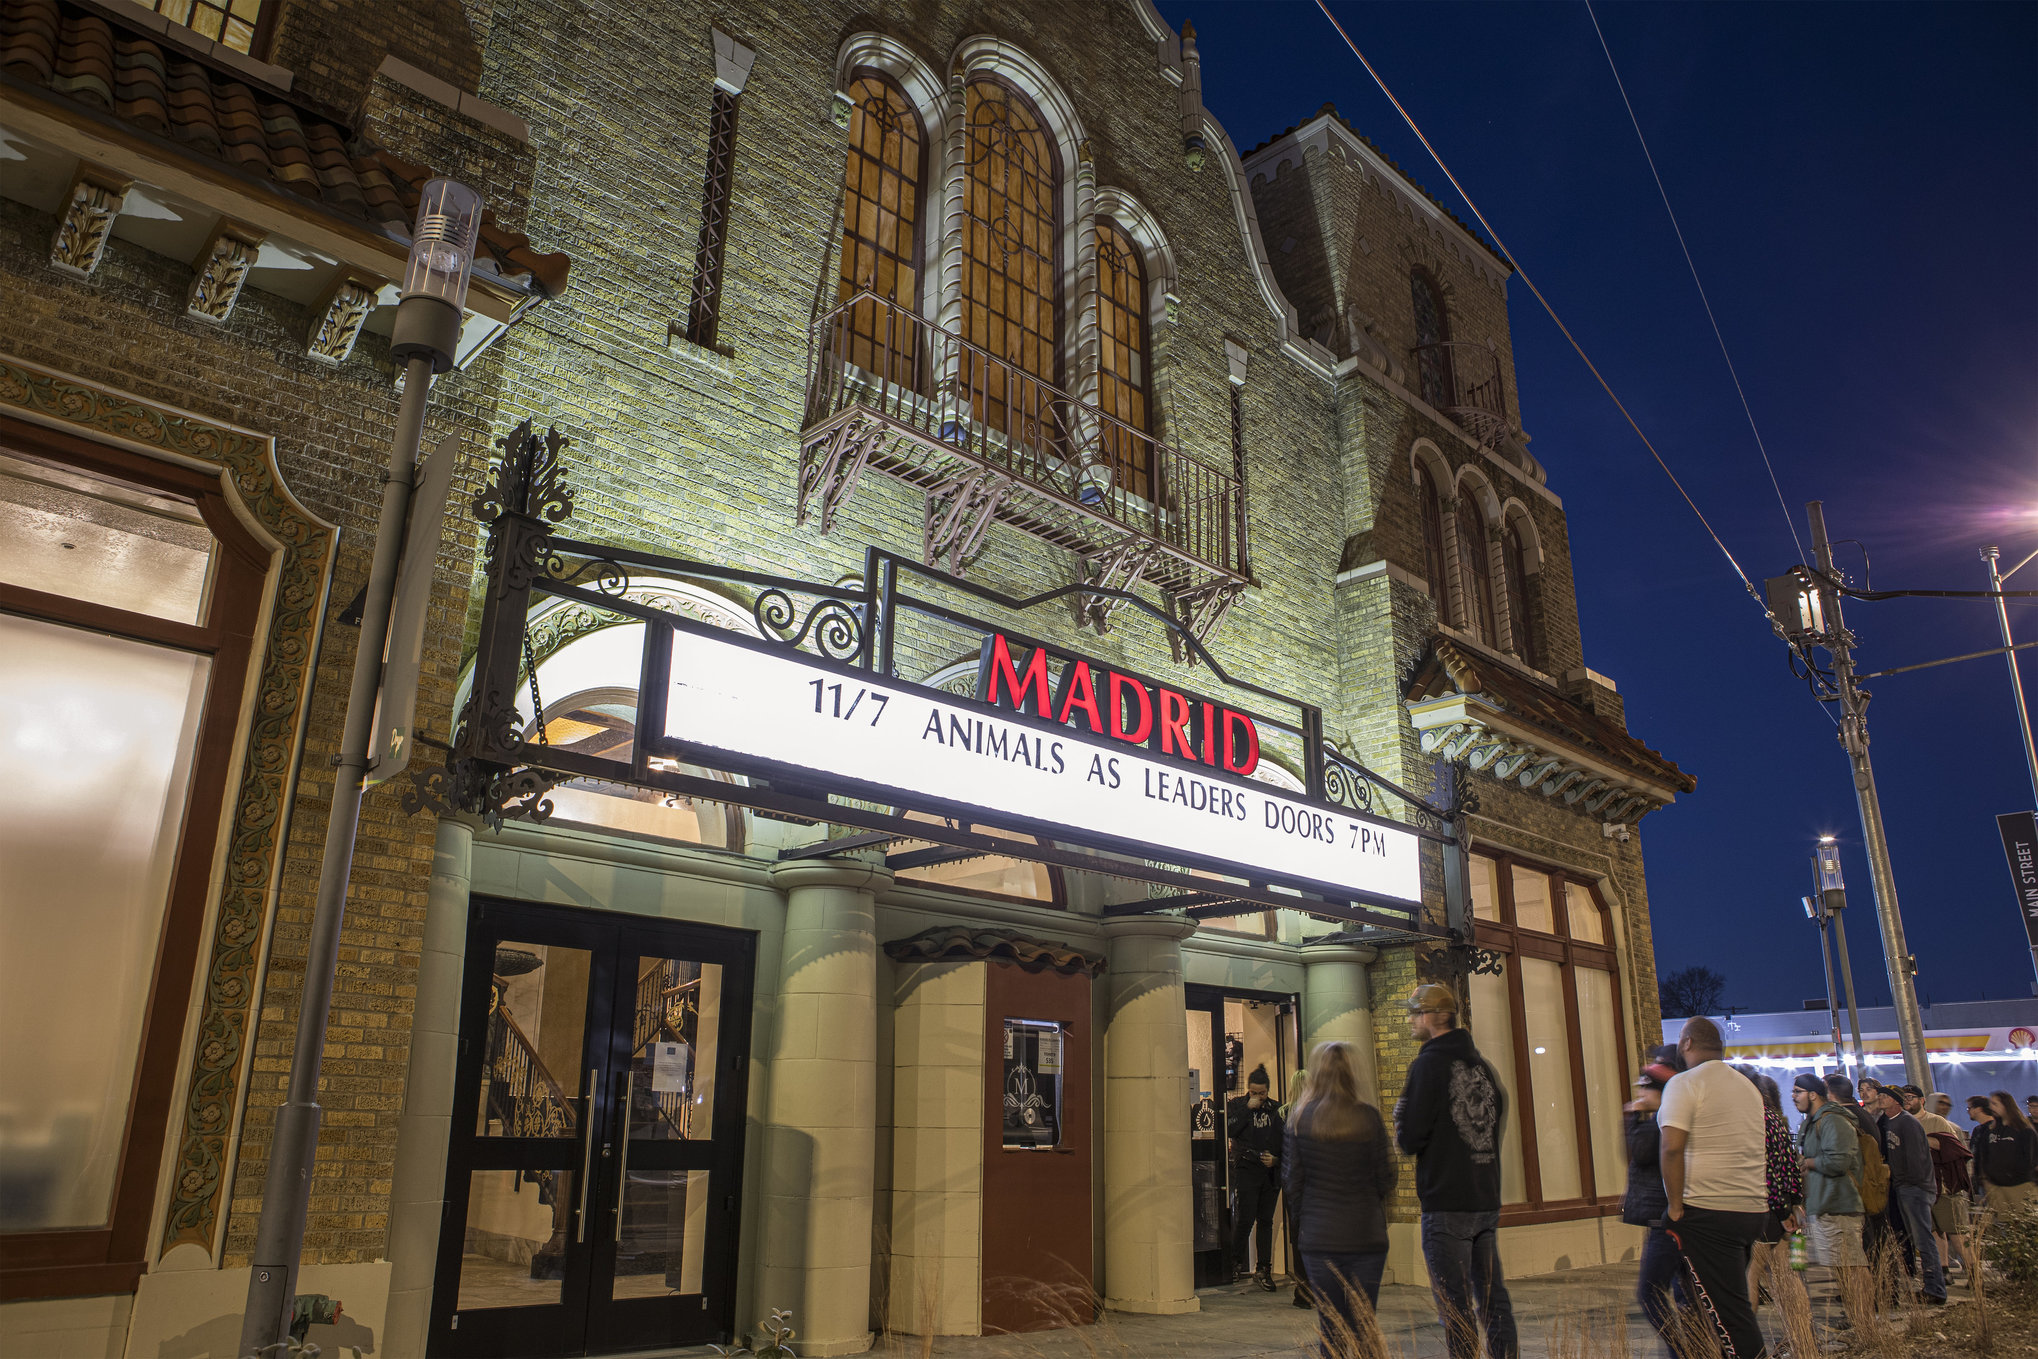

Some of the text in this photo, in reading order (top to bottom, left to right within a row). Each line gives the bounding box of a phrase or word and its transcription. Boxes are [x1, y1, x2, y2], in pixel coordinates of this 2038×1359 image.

[986, 633, 1260, 776] MADRID
[808, 678, 1386, 858] 11/7 ANIMALS AS LEADERS DOORS 7PM
[2015, 841, 2038, 917] MAIN STREET
[1014, 1078, 1029, 1095] M
